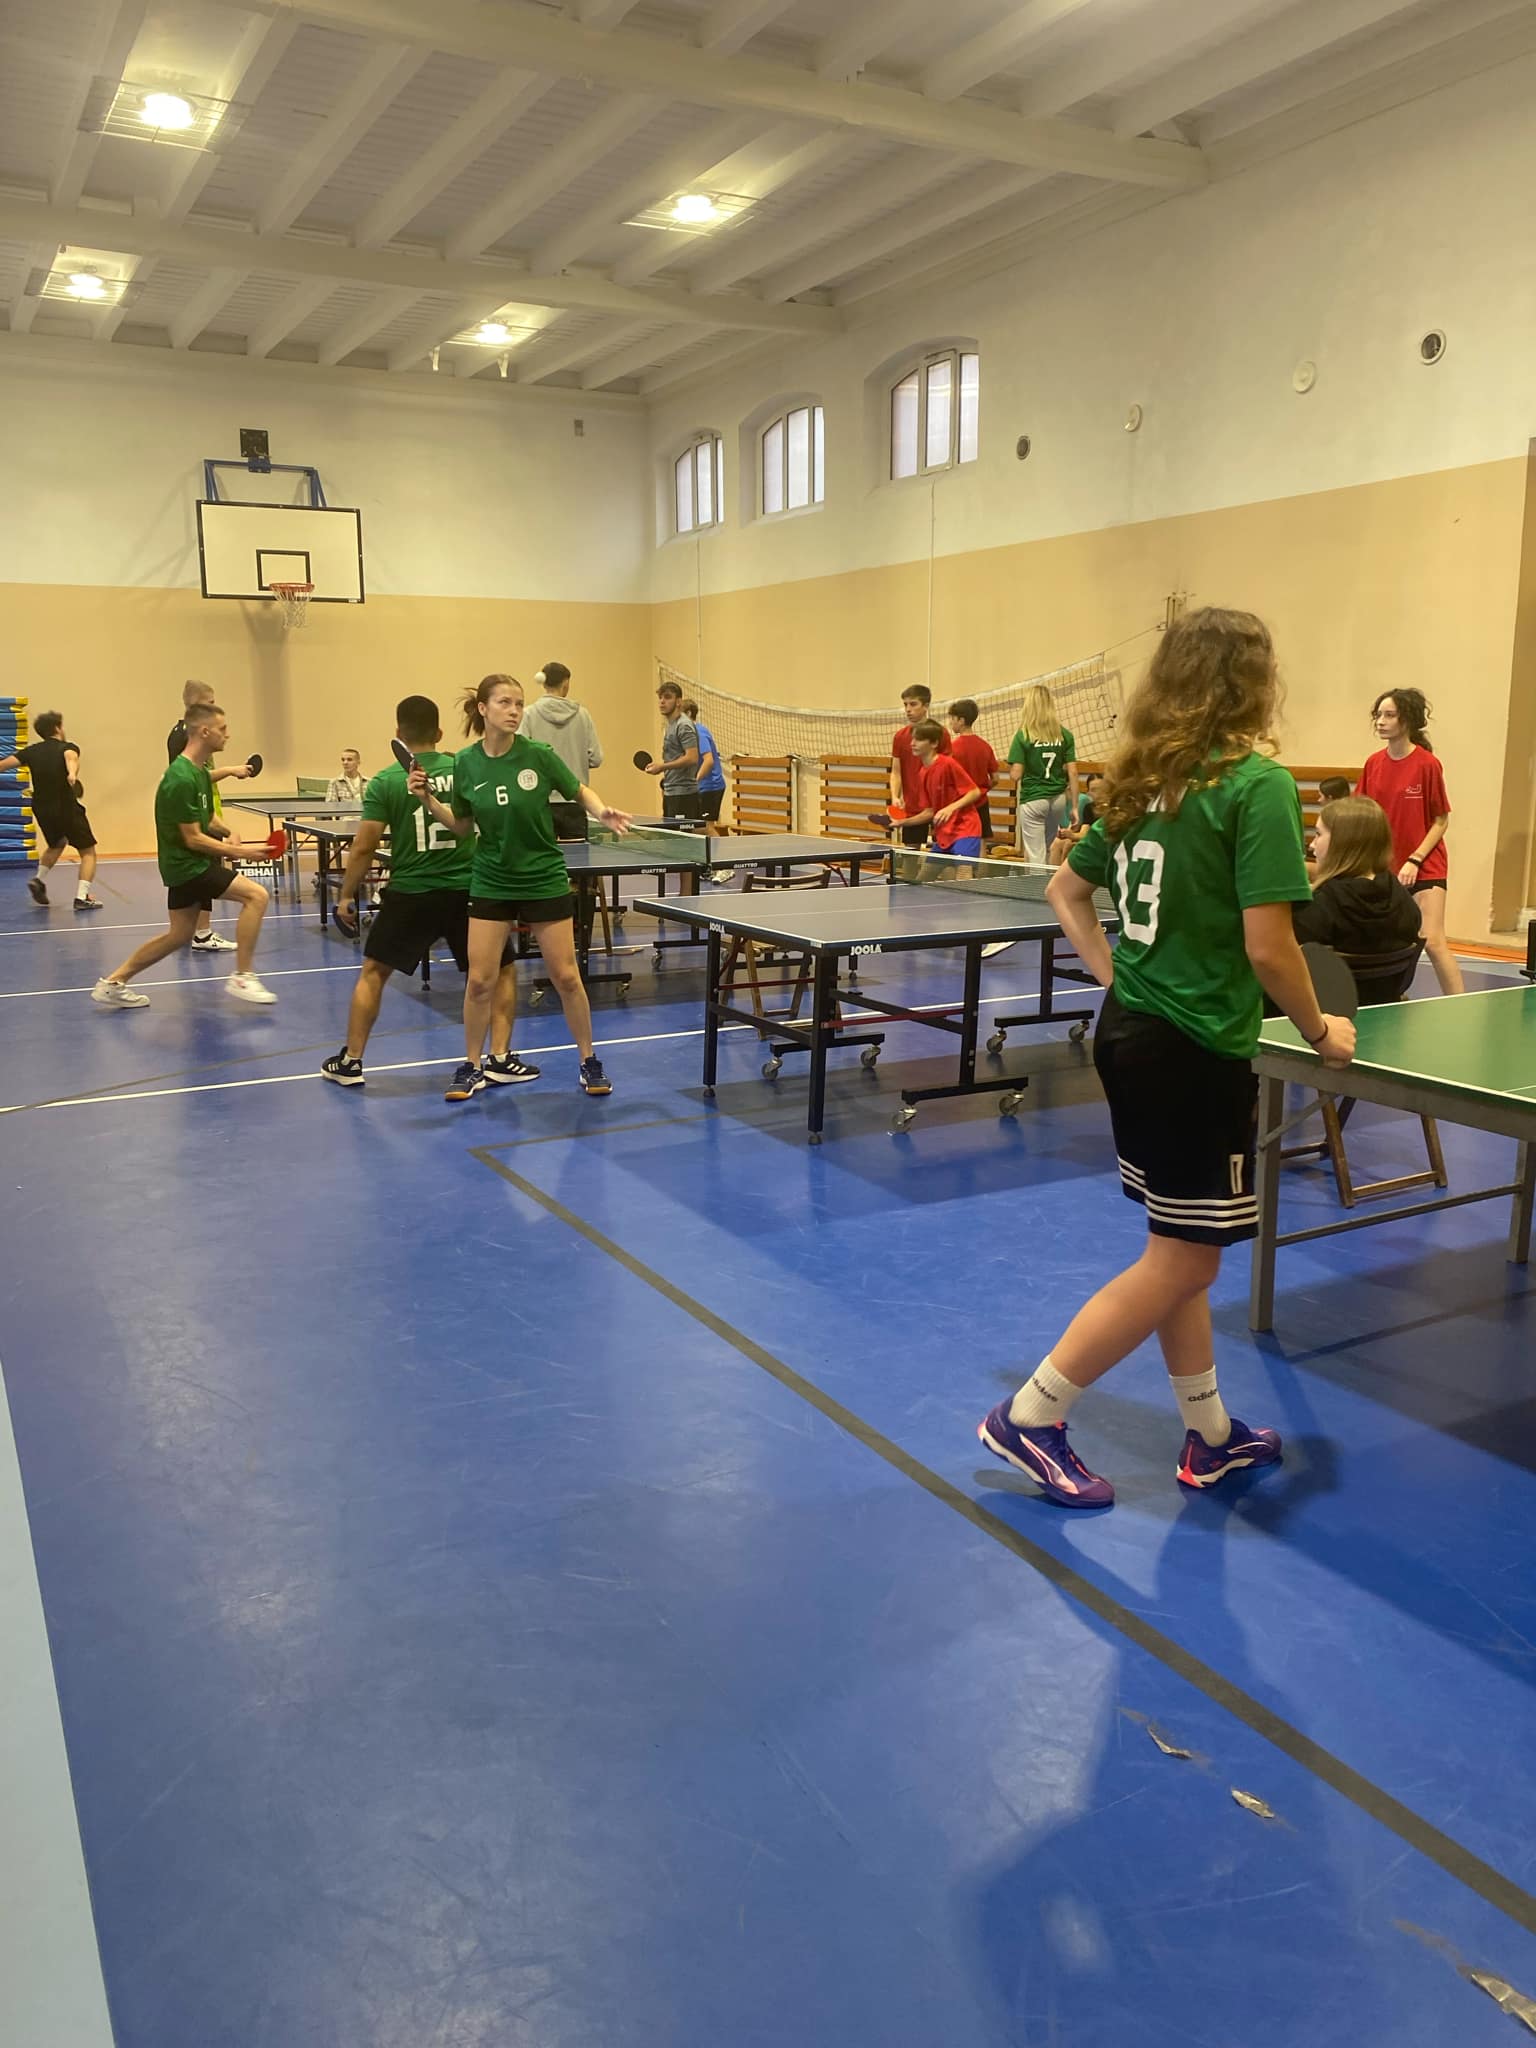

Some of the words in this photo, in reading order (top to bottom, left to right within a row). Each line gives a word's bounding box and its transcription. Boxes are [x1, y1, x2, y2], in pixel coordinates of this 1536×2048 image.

[1042, 752, 1056, 779] 7
[495, 785, 509, 806] 6
[412, 803, 457, 852] 12
[1113, 840, 1165, 946] 13
[710, 922, 725, 934] JOOLA
[850, 944, 882, 956] JOOLA
